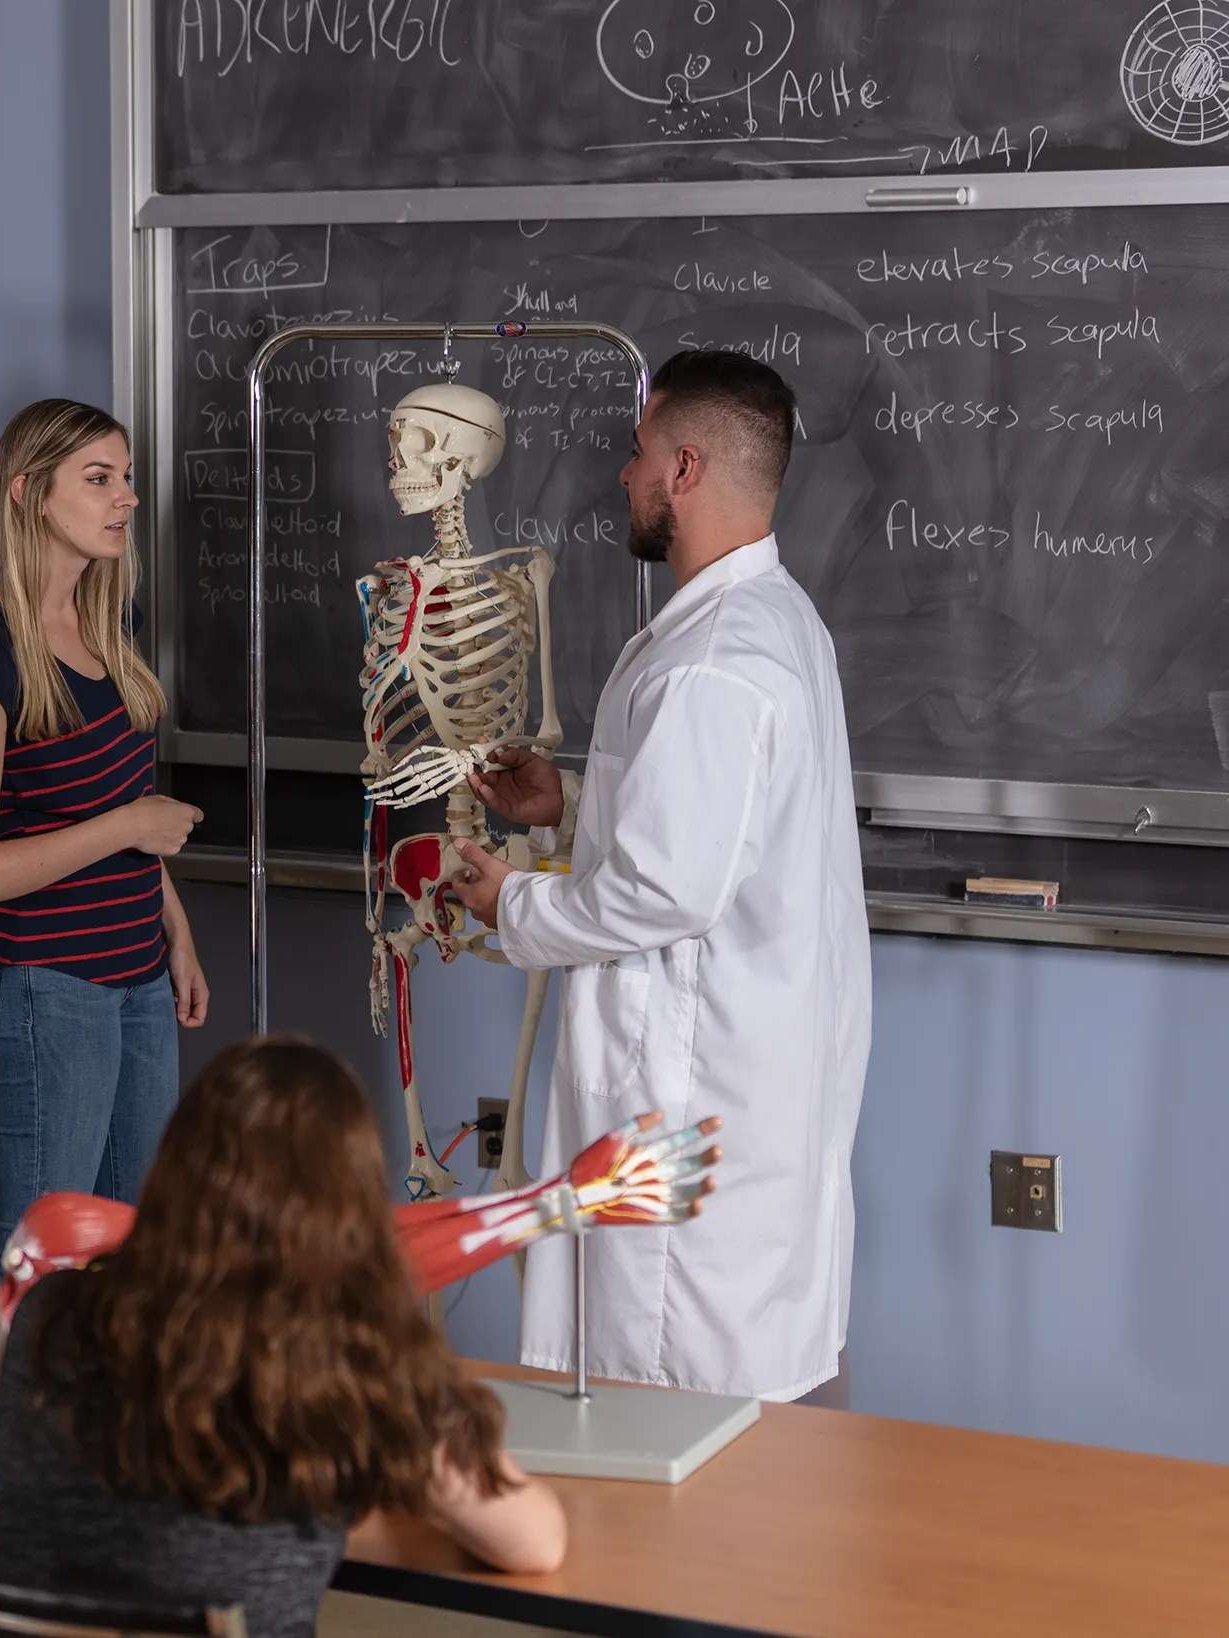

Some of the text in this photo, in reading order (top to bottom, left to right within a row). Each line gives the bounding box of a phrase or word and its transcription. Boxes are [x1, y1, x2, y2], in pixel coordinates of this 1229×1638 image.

[938, 124, 1049, 173] MAP
[191, 234, 299, 300] Traps
[674, 262, 773, 293] Clavicle
[856, 247, 1013, 282] elevates
[554, 293, 578, 314] and
[865, 312, 1026, 357] retracts
[502, 365, 527, 389] of
[500, 402, 561, 420] pinous
[875, 391, 1020, 443] depresses
[515, 426, 534, 449] of
[194, 459, 302, 493] Deltds
[886, 499, 1155, 564] flexes humerus
